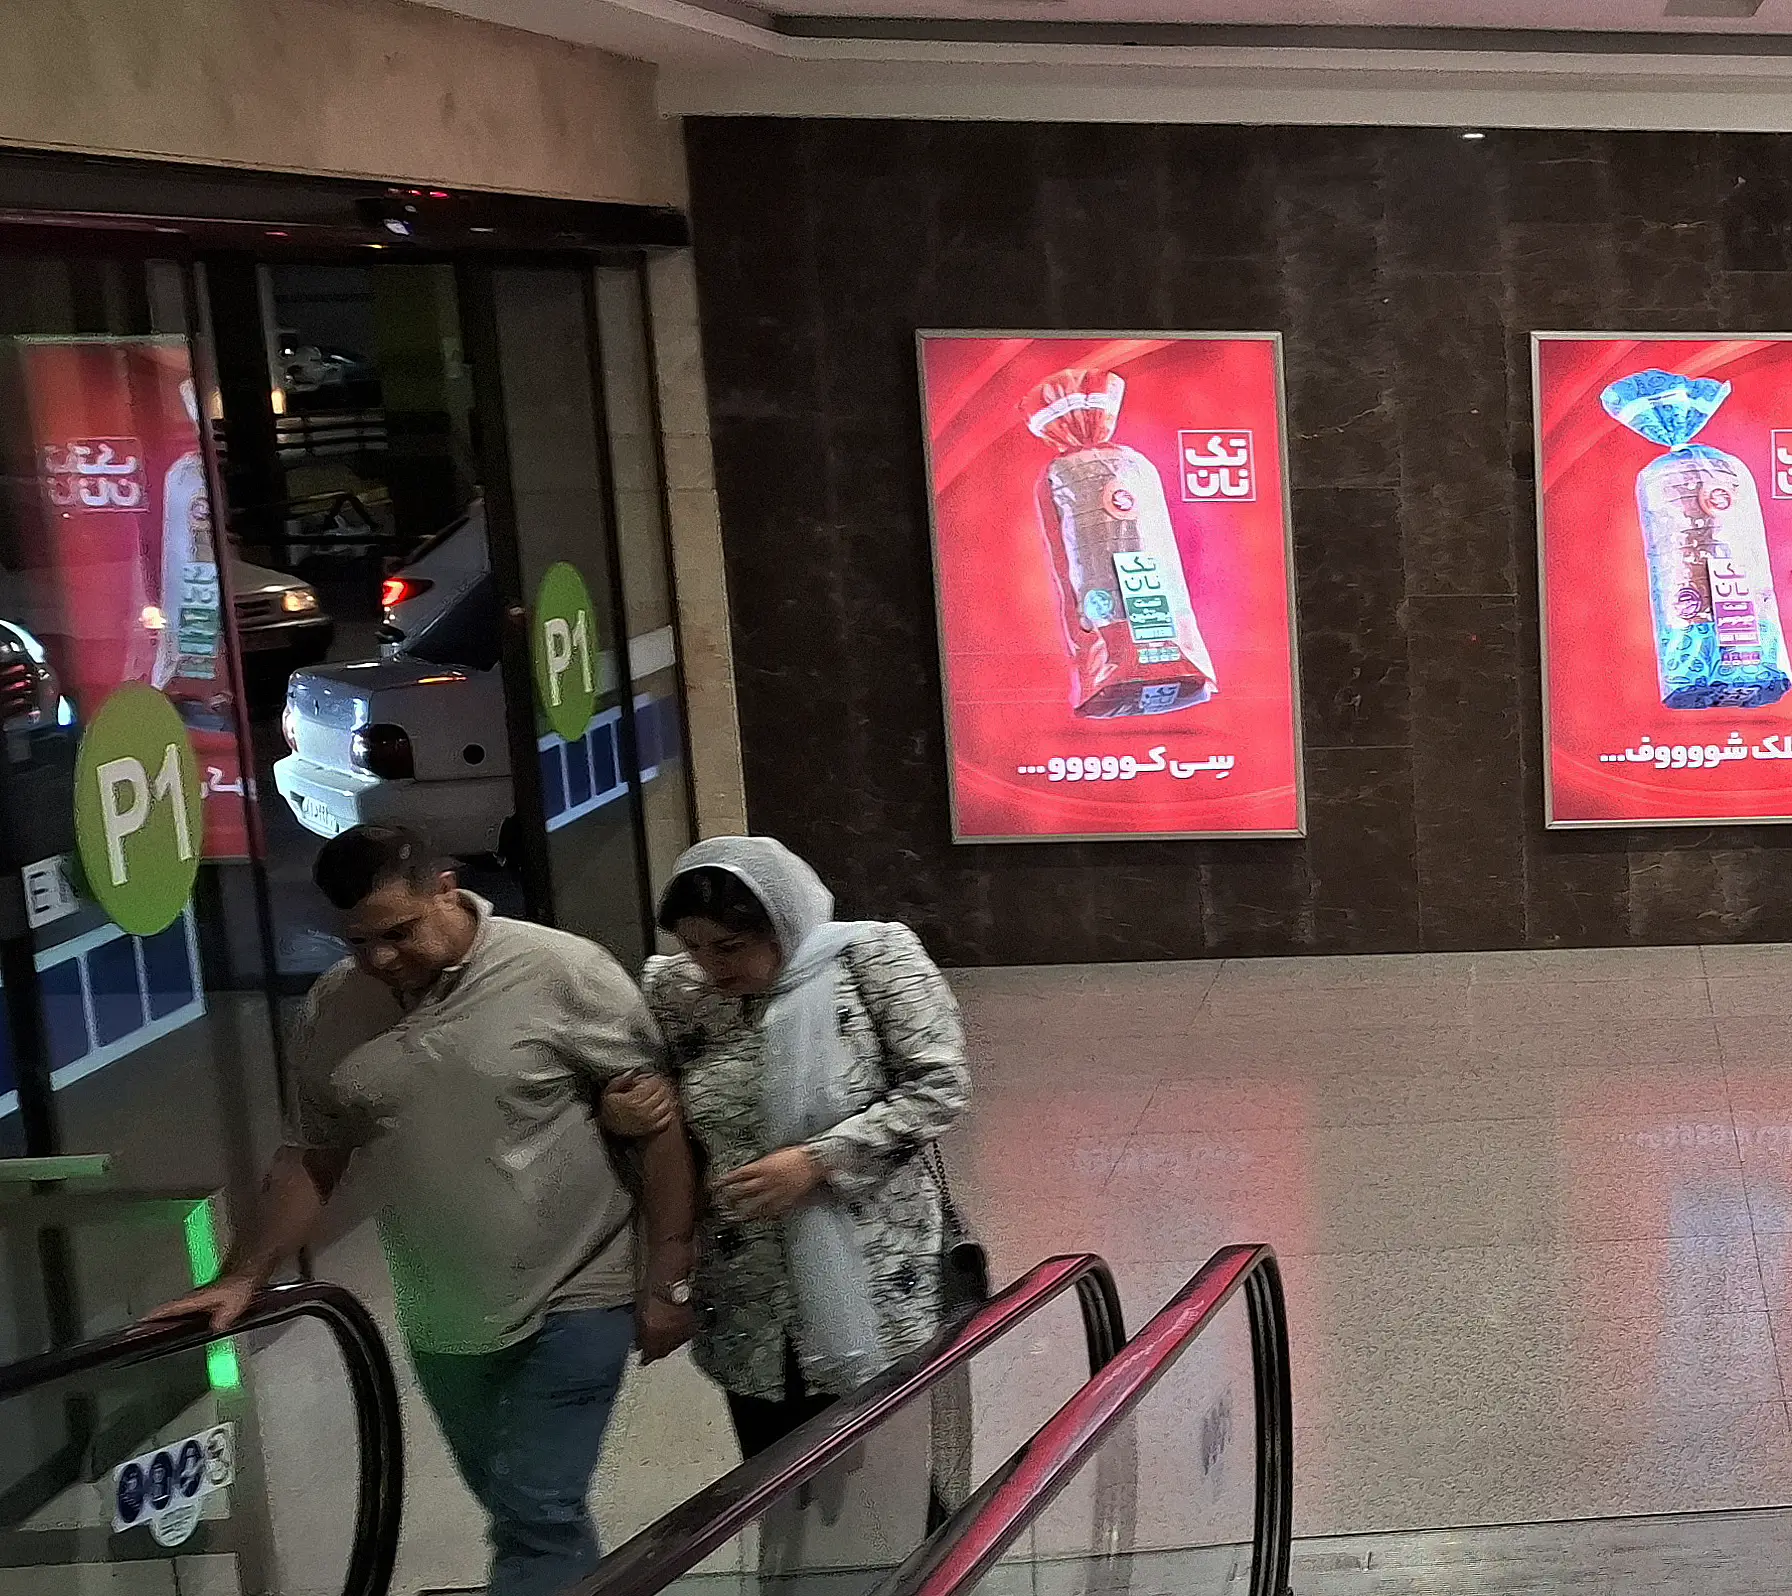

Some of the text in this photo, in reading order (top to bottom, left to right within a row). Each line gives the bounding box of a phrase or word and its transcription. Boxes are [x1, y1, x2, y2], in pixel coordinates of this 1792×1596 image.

[1185, 435, 1248, 466] تک
[1186, 467, 1249, 497] نان
[544, 609, 594, 707] P1
[96, 743, 193, 887] P1
